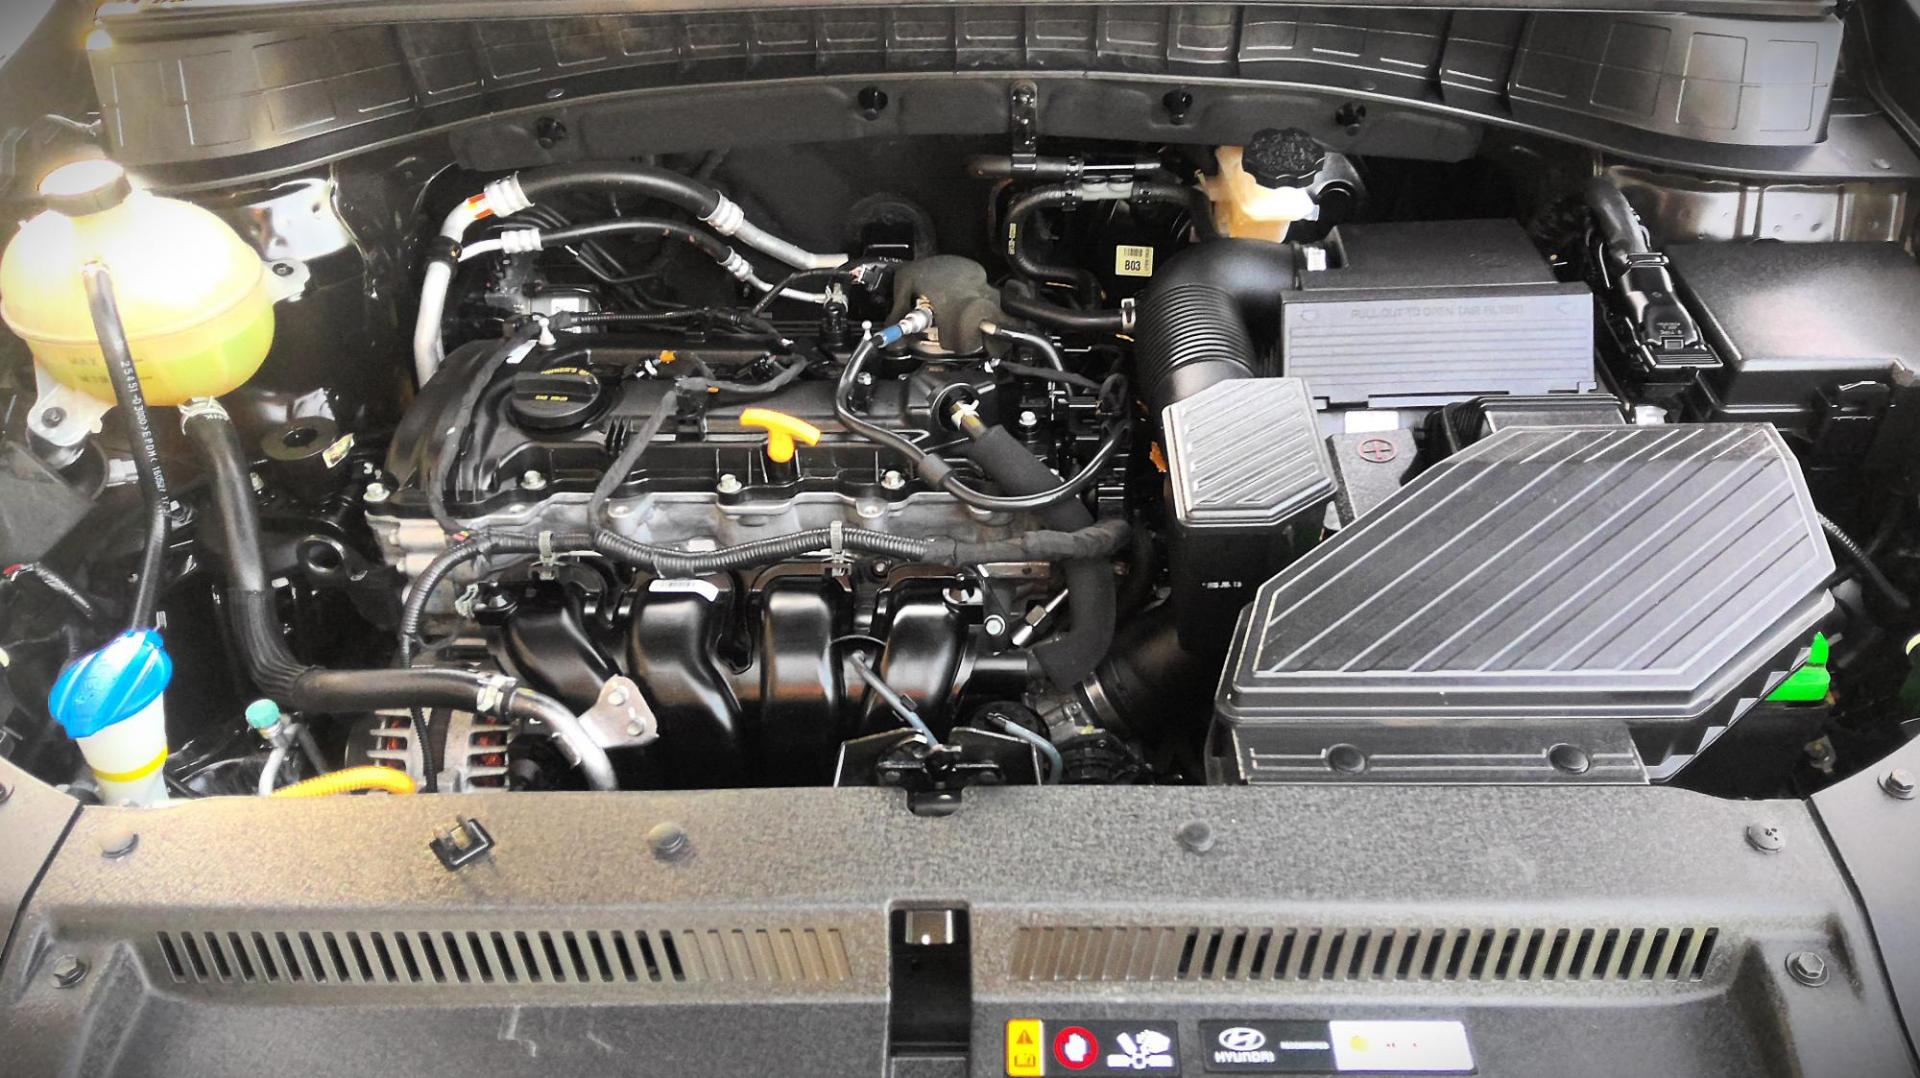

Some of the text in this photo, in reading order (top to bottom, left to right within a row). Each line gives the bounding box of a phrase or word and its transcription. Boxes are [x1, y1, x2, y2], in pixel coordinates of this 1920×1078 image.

[1350, 308, 1378, 320] PULL
[1381, 307, 1403, 318] OUT
[1213, 1050, 1276, 1063] HYUNDAI
